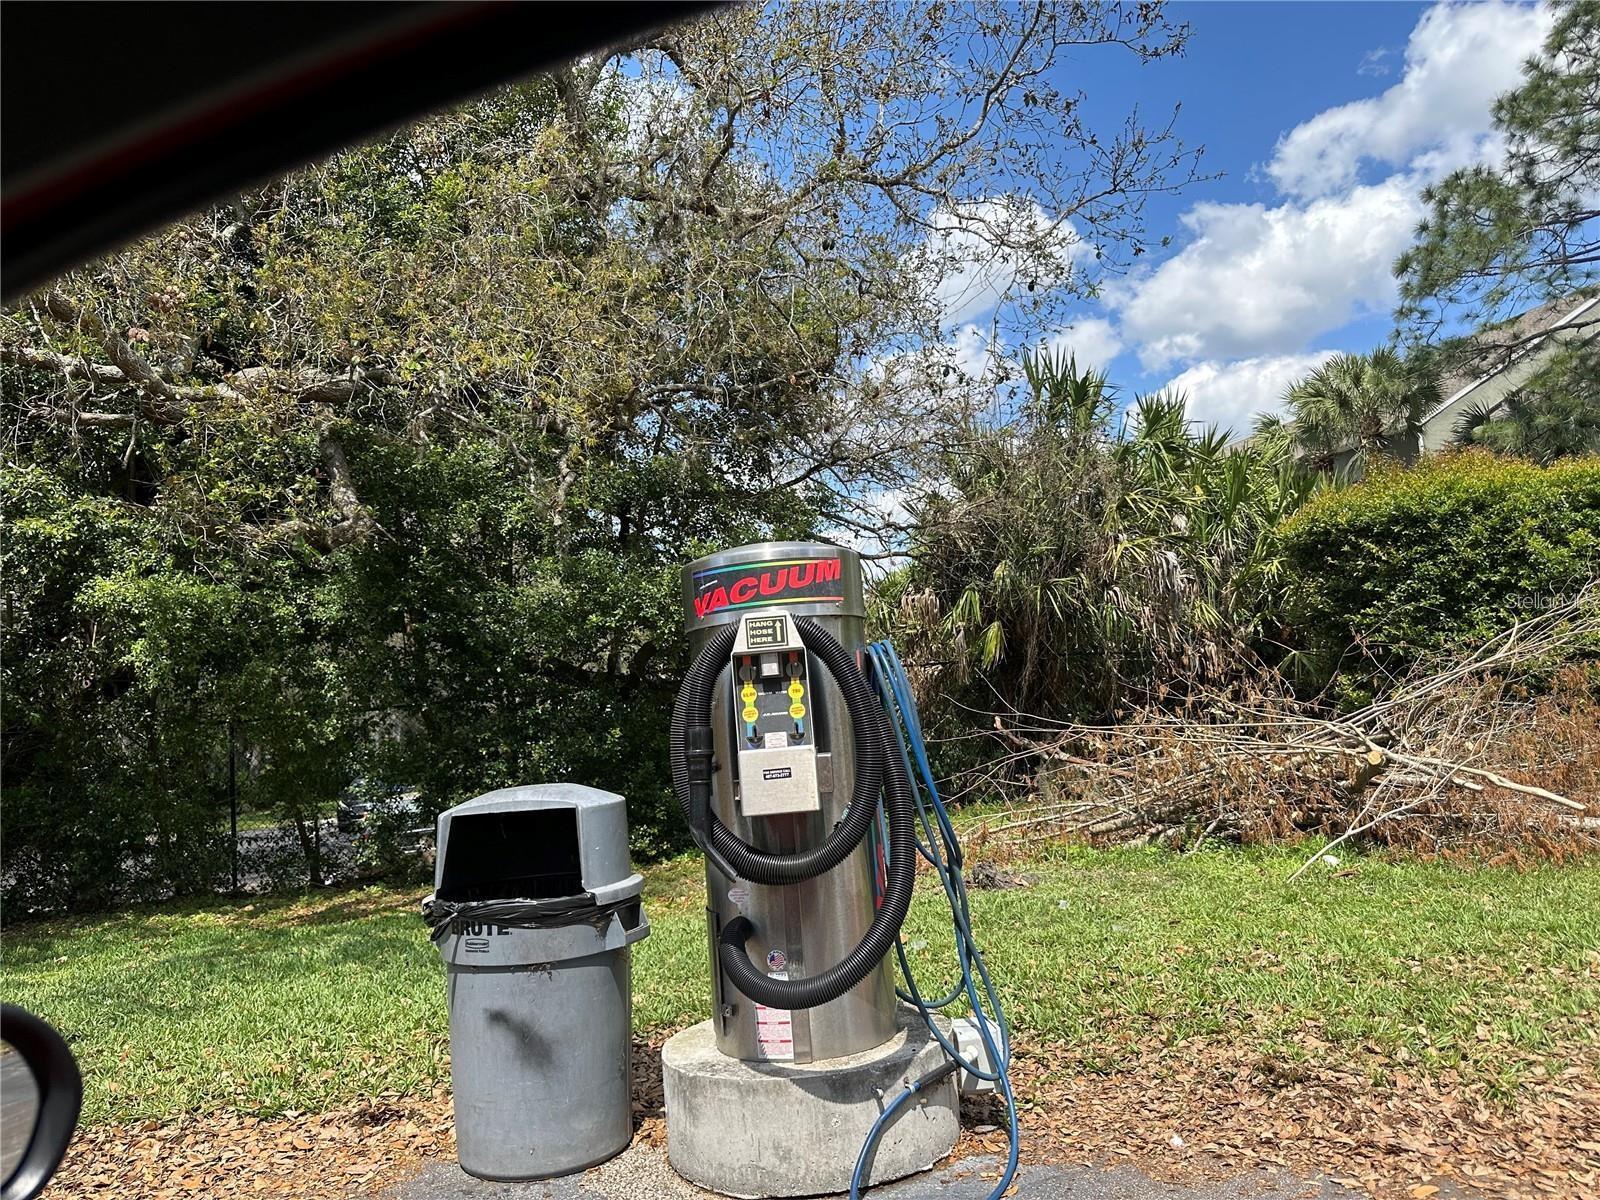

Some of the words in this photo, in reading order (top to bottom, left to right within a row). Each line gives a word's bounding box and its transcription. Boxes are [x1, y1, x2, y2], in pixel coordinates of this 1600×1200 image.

[694, 559, 841, 618] VACUUM
[750, 620, 773, 628] HANG
[750, 628, 773, 636] HOSE
